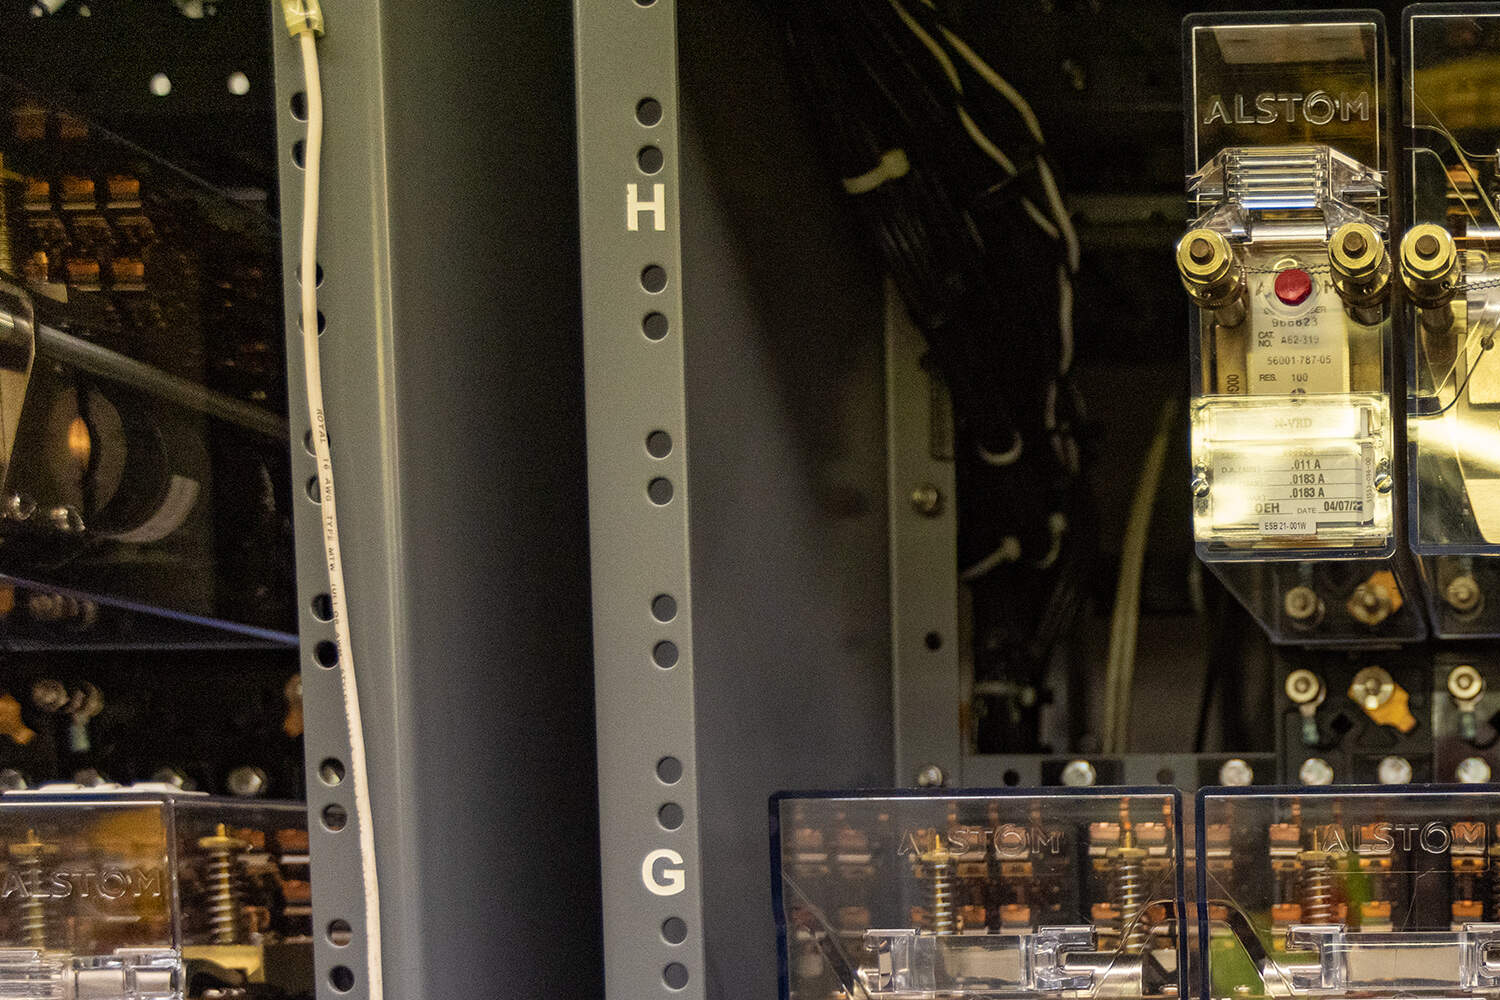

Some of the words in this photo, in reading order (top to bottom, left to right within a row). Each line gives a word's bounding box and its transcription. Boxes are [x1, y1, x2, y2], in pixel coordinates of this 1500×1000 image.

[1202, 90, 1371, 125] ALSTOM
[626, 184, 666, 231] H
[1289, 474, 1315, 485] .0183
[1318, 474, 1325, 484] A
[1314, 459, 1321, 469] A
[1289, 488, 1315, 498] .0183
[1318, 488, 1325, 498] A
[1264, 521, 1279, 530] ESB
[897, 824, 1066, 857] ALSTOM
[1318, 820, 1487, 858] ALSTOM
[1, 869, 161, 900] ALSTOM
[642, 848, 686, 896] G
